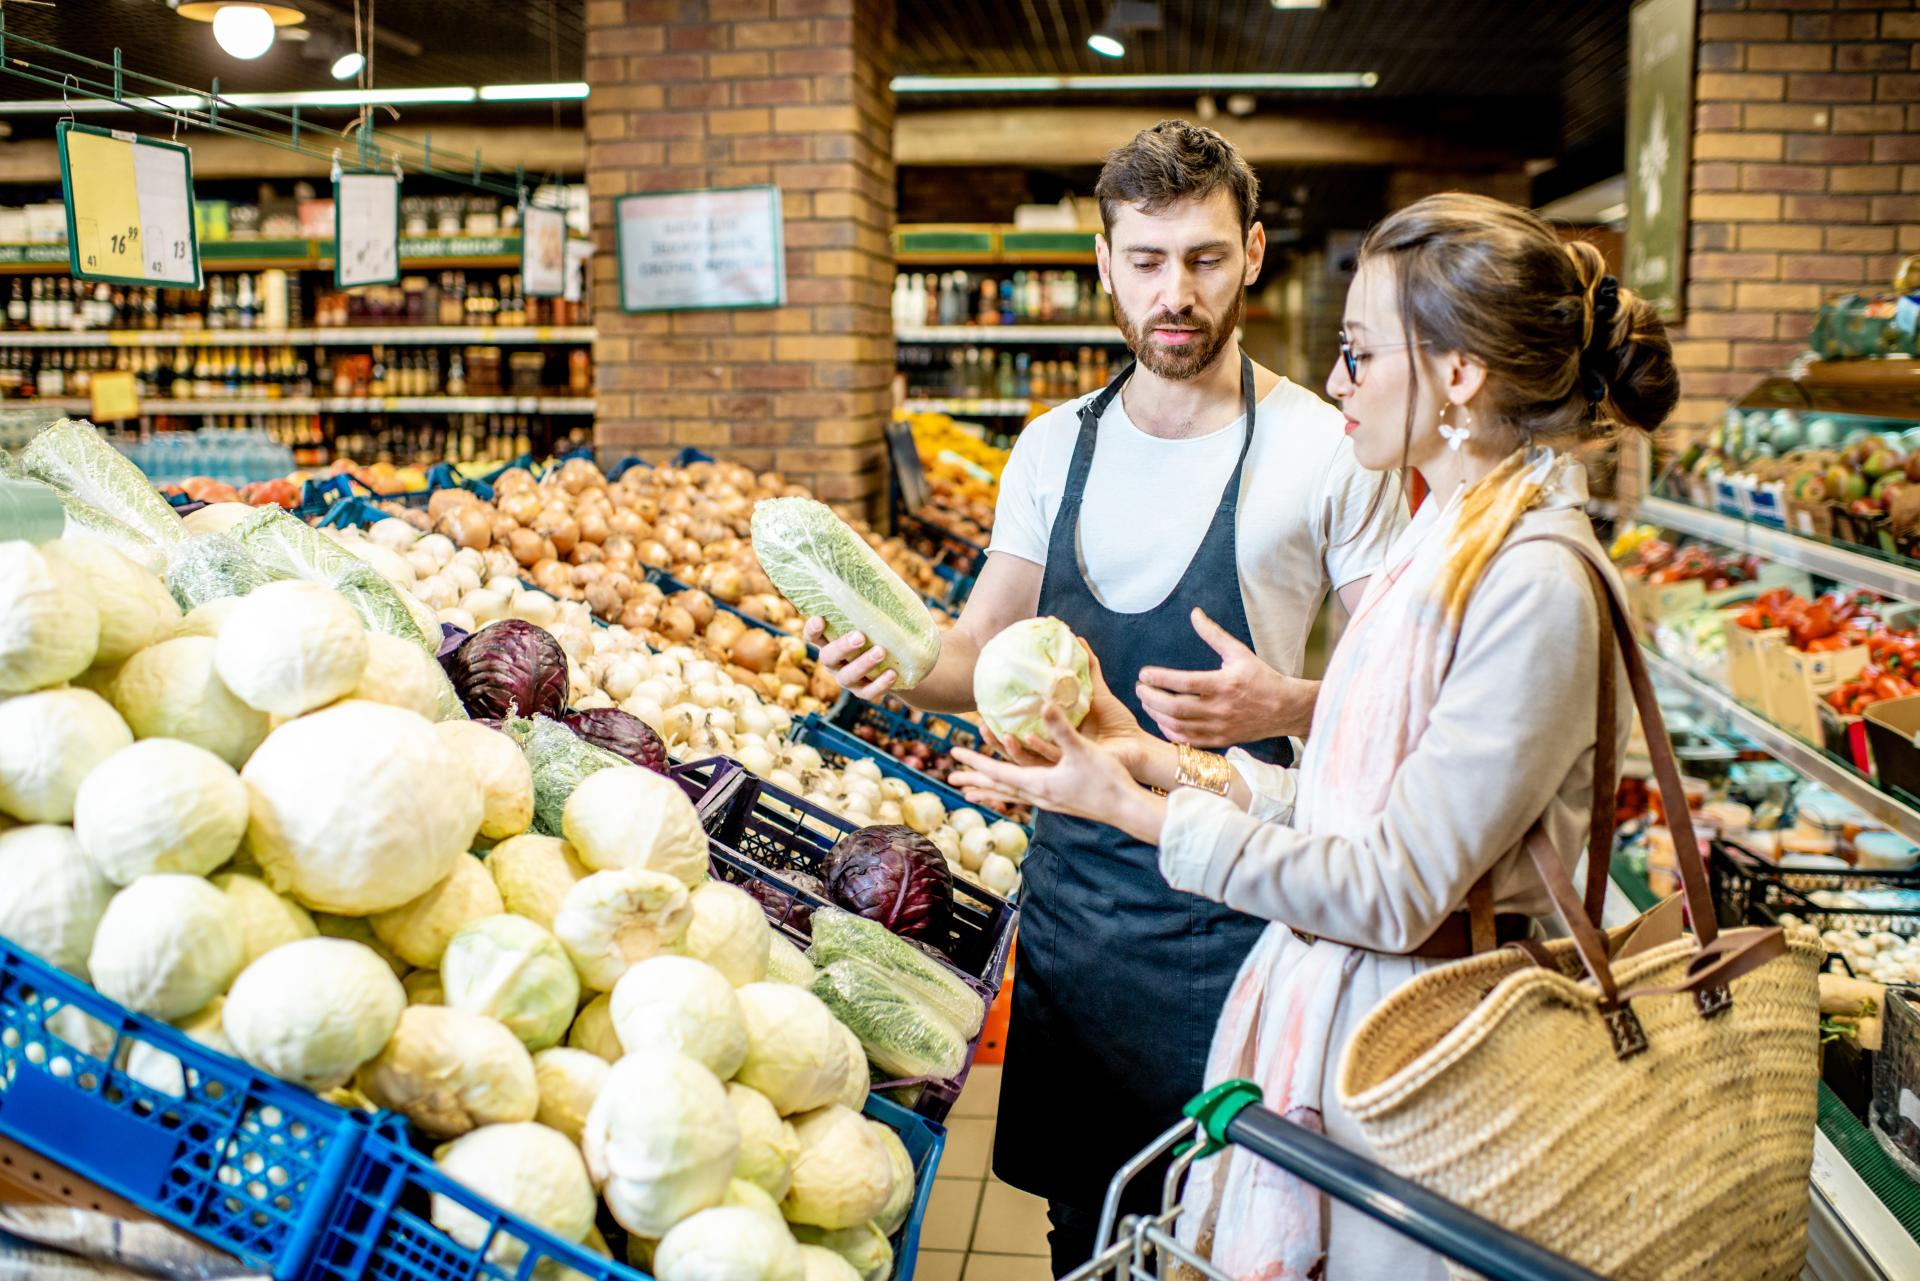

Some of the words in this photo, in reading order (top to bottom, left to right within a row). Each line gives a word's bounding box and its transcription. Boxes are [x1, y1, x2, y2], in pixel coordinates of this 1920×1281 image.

[111, 235, 126, 255] 16
[128, 227, 138, 240] 99
[173, 241, 185, 259] 13
[87, 255, 97, 267] 41
[152, 261, 162, 273] 42
